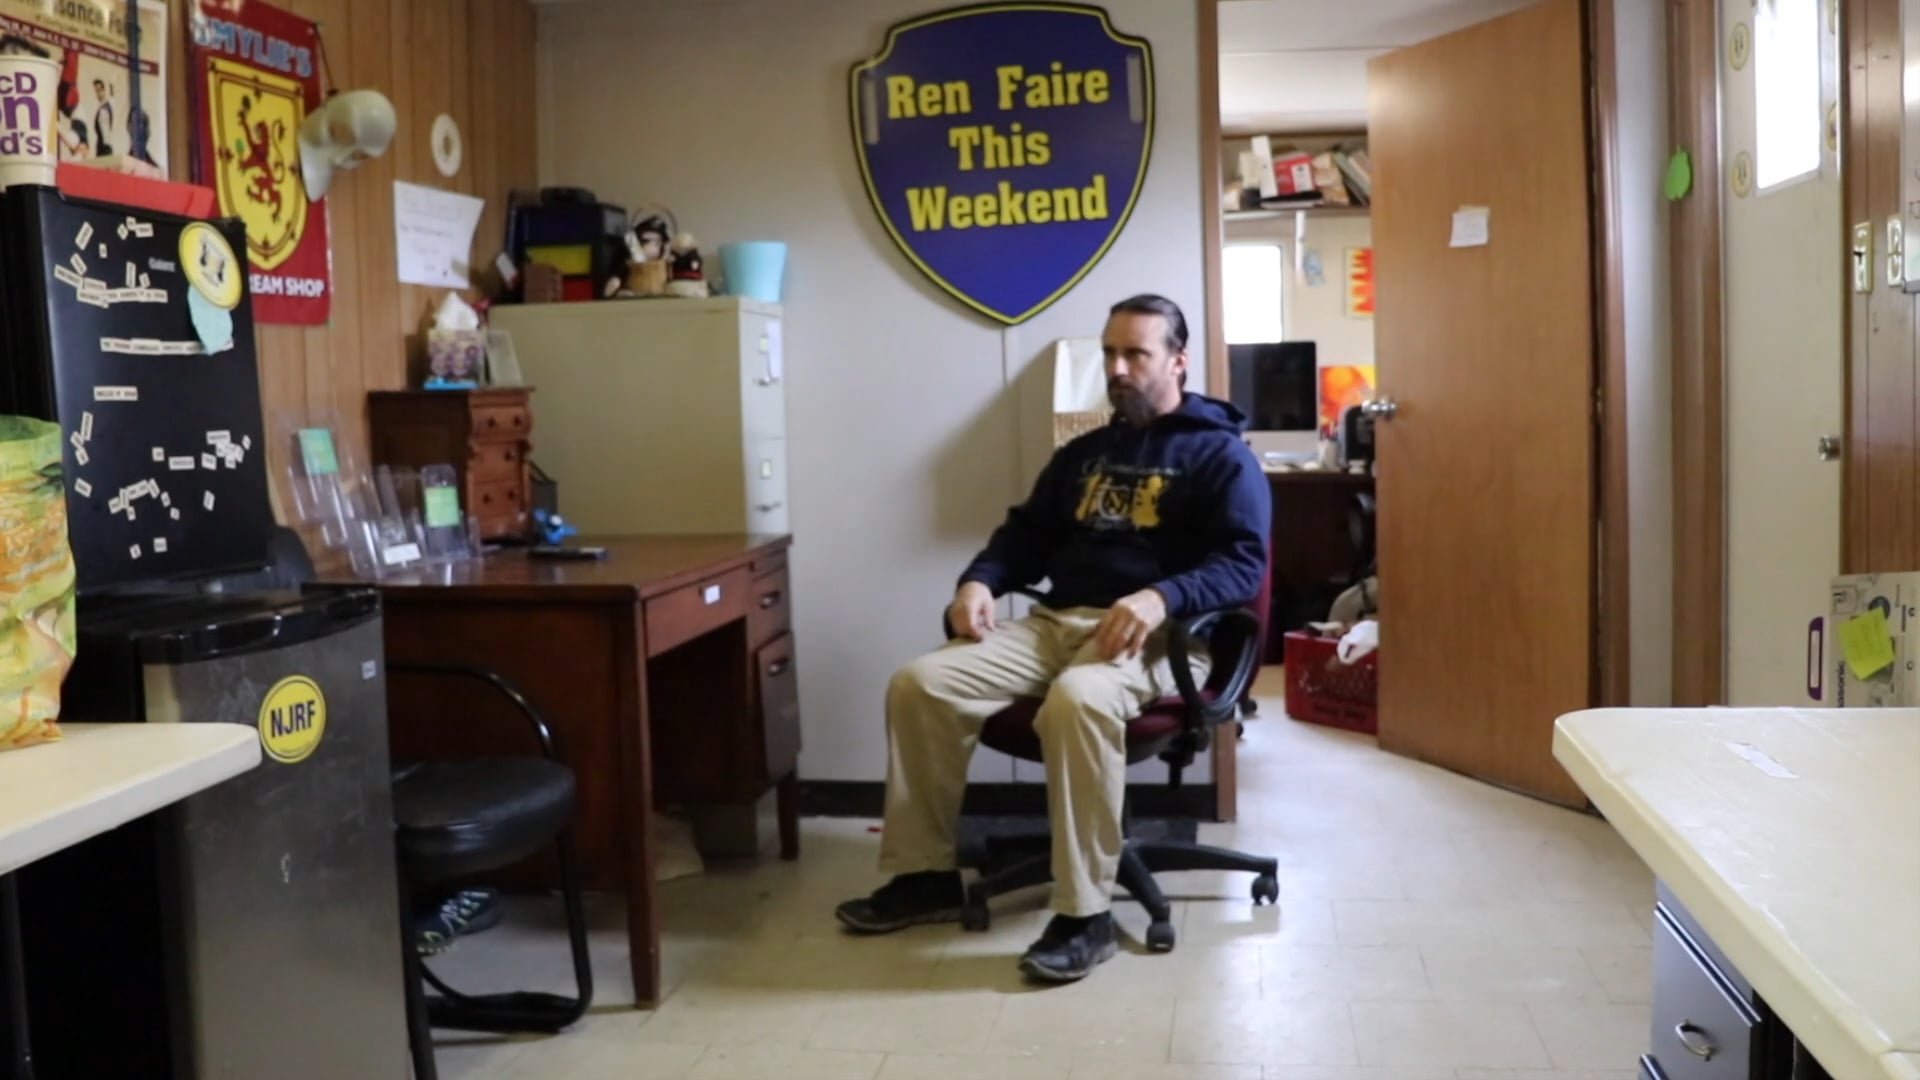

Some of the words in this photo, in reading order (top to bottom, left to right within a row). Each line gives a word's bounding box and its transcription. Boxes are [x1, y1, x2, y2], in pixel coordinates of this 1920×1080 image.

[886, 74, 971, 119] Ren
[997, 61, 1109, 110] Faire
[949, 122, 1051, 170] This
[906, 174, 1108, 232] Weekend
[285, 276, 325, 299] SHOP
[270, 699, 316, 739] NJRF
